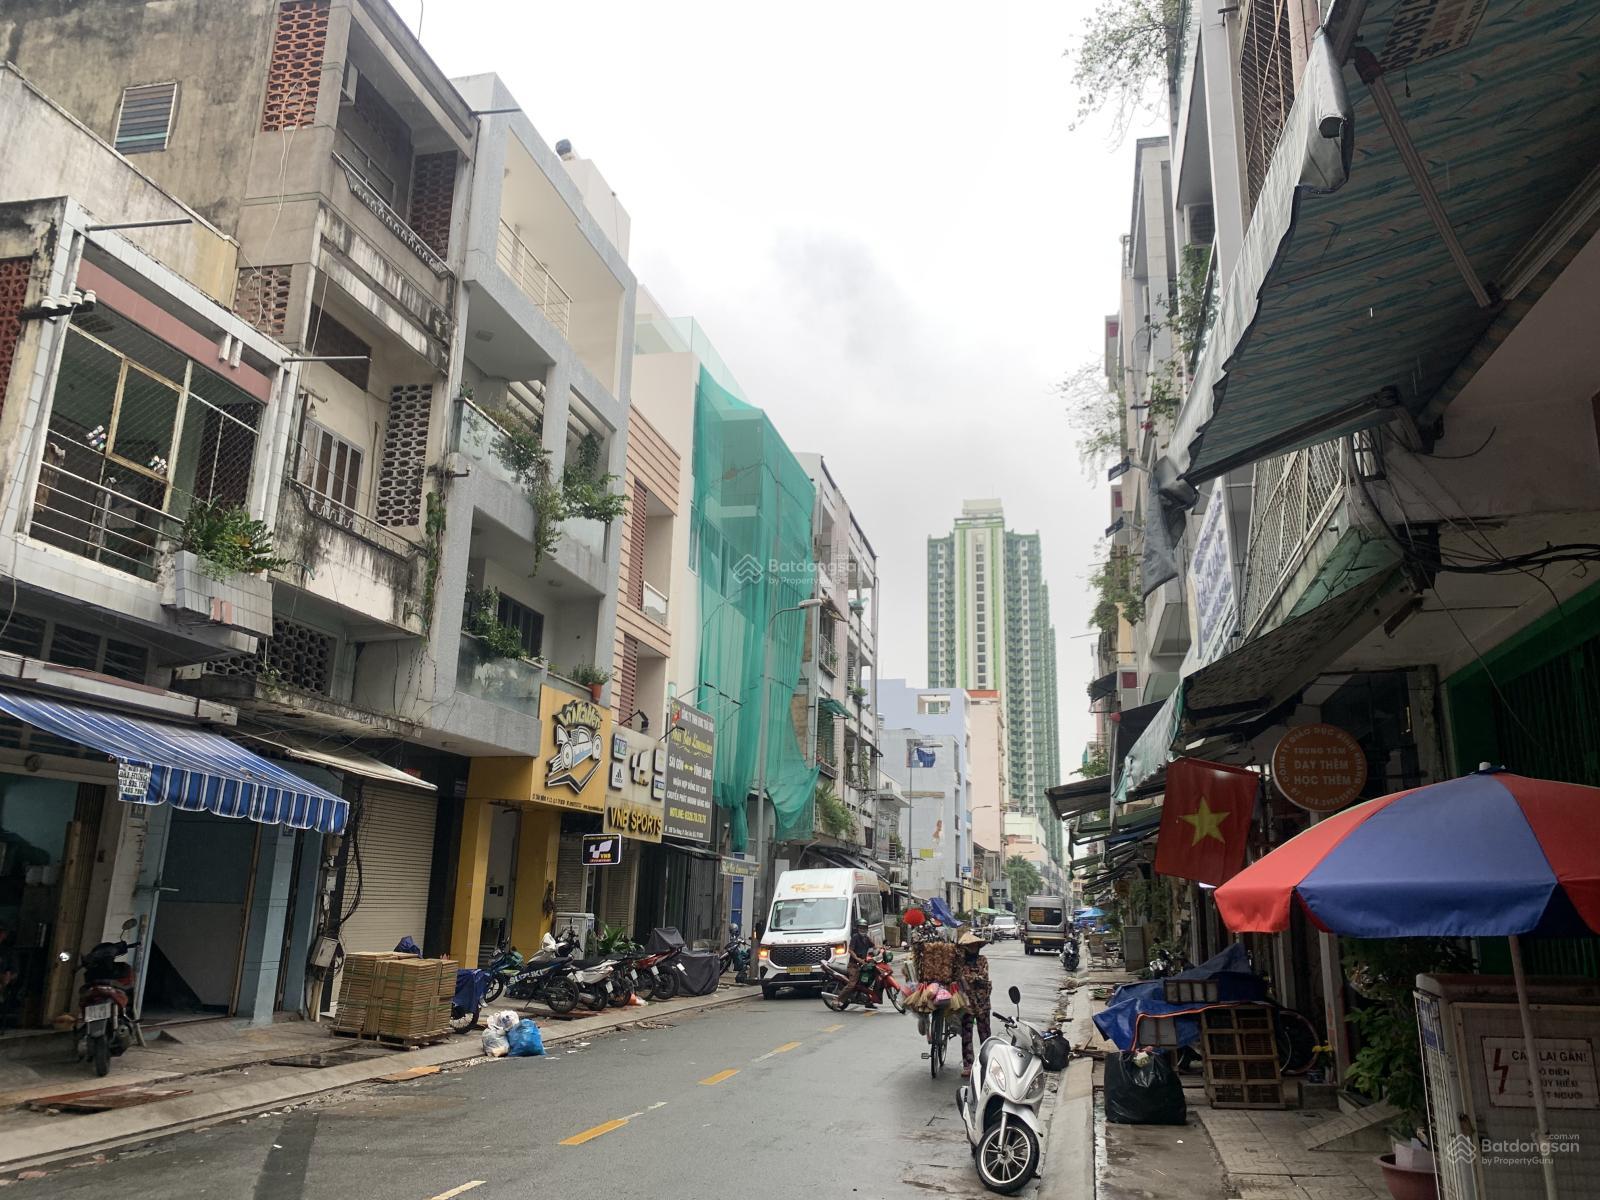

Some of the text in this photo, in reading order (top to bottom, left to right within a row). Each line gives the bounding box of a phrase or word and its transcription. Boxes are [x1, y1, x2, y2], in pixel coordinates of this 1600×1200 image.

[1319, 758, 1349, 770] THÊM
[1294, 774, 1351, 788] HỌC THÊM
[610, 807, 628, 829] VNB
[631, 810, 662, 833] SPORTS
[509, 969, 544, 984] SUZUKI
